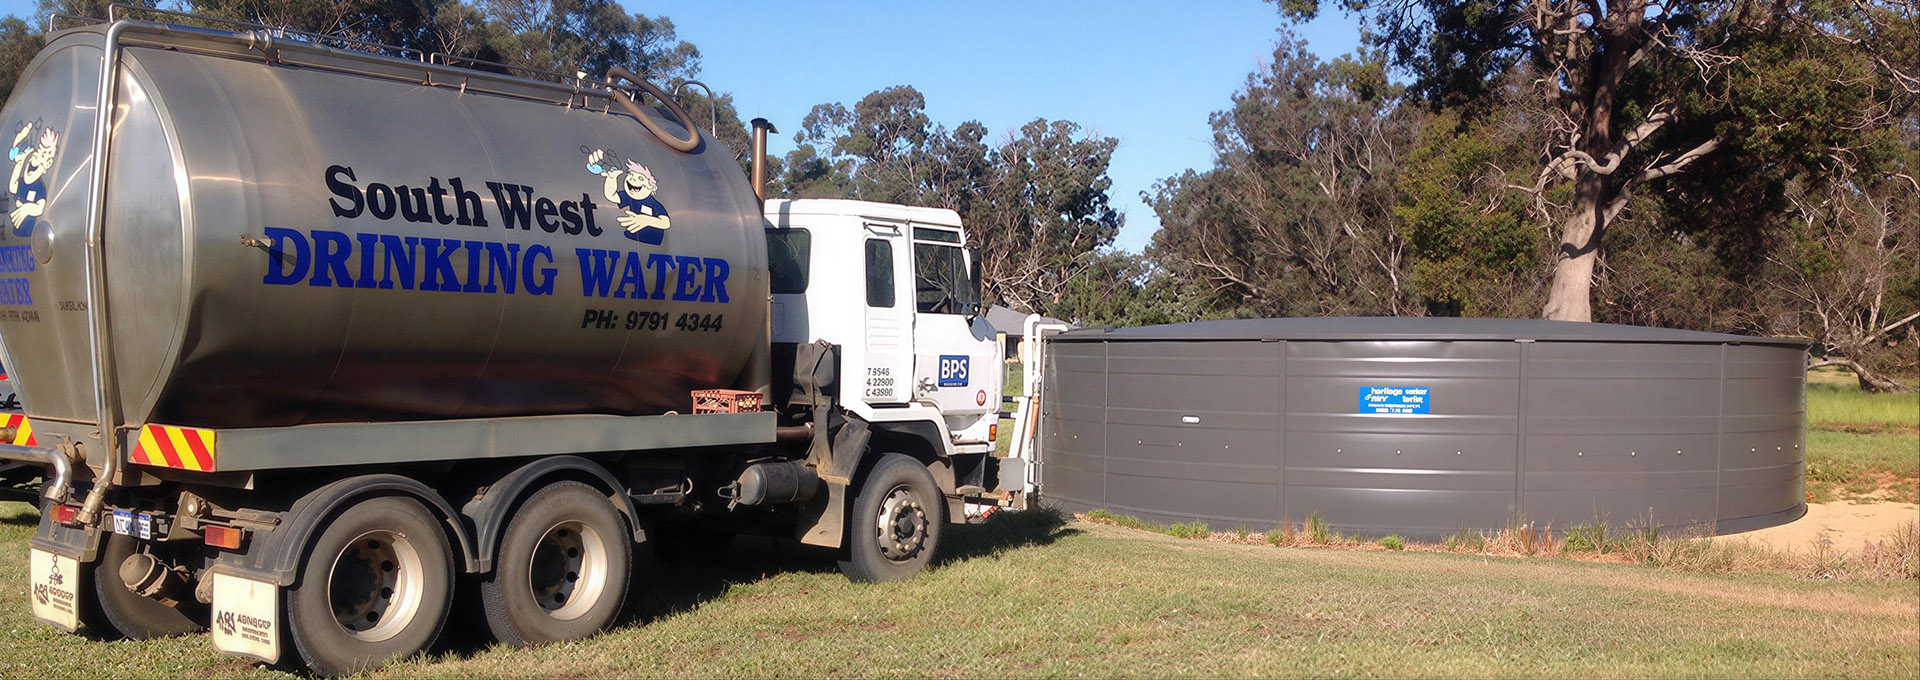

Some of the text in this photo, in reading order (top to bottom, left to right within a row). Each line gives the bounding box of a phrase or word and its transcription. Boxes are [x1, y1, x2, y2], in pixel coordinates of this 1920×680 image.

[324, 164, 603, 237] South West
[263, 226, 730, 304] DRINKING WATER
[581, 309, 724, 334] PH: 9791 4344
[941, 358, 967, 380] BPS
